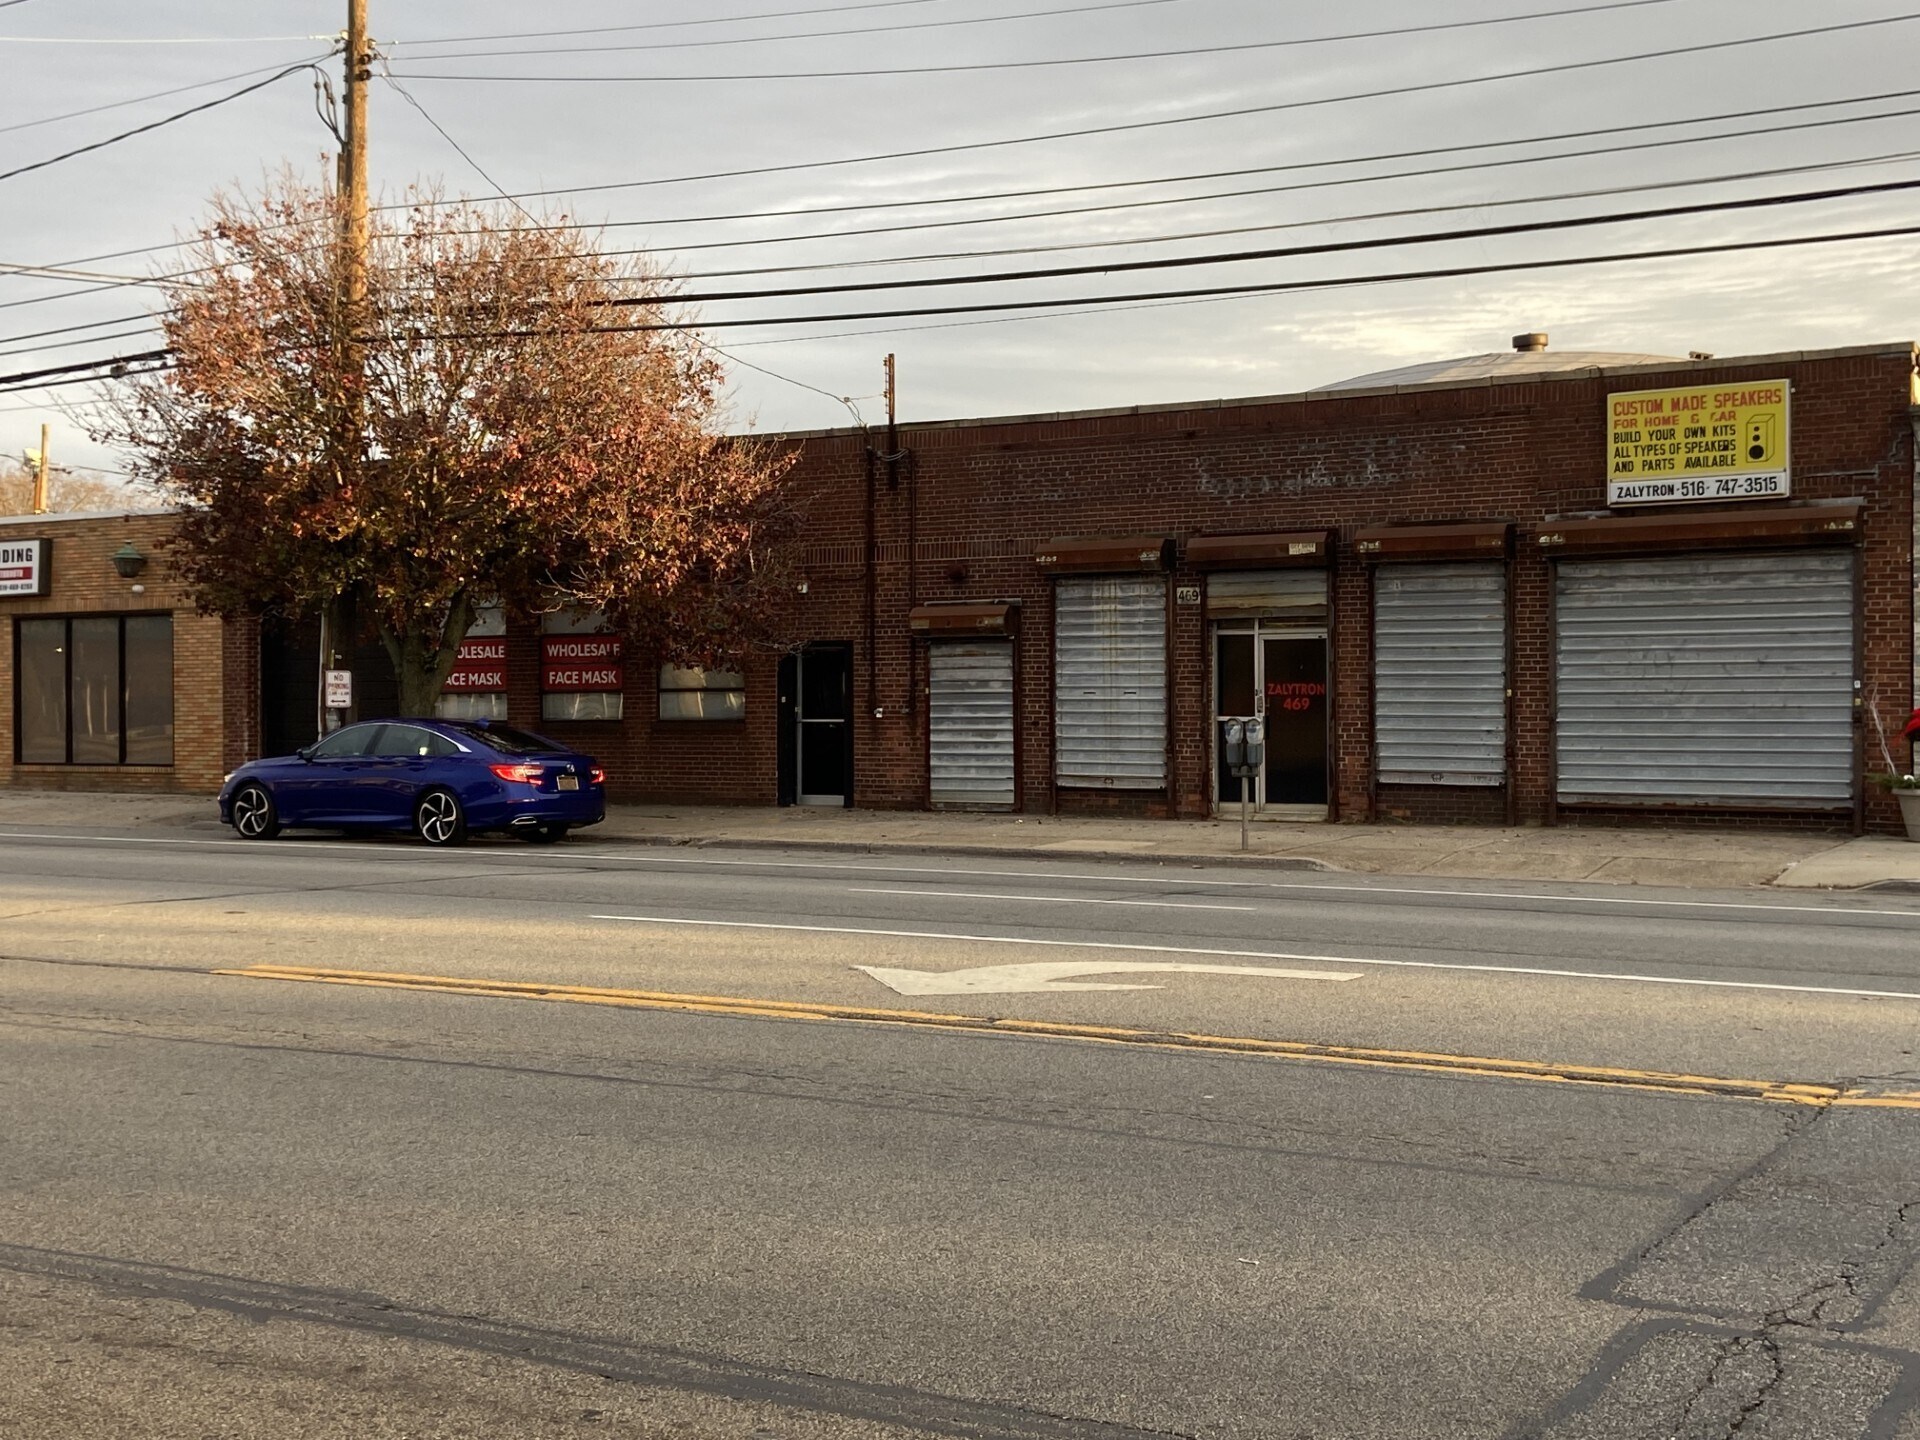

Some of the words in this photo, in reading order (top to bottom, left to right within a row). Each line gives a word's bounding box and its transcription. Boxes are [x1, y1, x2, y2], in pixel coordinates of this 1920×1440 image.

[1614, 398, 1664, 417] CUSTOM
[1671, 394, 1708, 413] MADE
[1714, 388, 1782, 409] SPEAKERS
[1614, 418, 1638, 430] FOR
[1644, 414, 1680, 428] HOME
[1710, 410, 1737, 423] CAR
[1614, 430, 1642, 444] BUILD
[1647, 428, 1676, 441] YOUR
[1685, 426, 1706, 439] OWN
[1712, 424, 1736, 437] KITS
[1614, 446, 1631, 459] ALL
[1633, 444, 1666, 457] TYPES
[1670, 442, 1682, 455] OF
[1685, 438, 1736, 454] SPEAKERS
[1614, 460, 1634, 473] AND
[1641, 457, 1675, 471] PARTS
[1685, 453, 1736, 469] AVAILABLE
[0, 548, 33, 563] DING
[1178, 589, 1199, 602] 469
[457, 645, 505, 659] OLESALE
[446, 672, 466, 686] ACE
[468, 672, 502, 686] MASK
[549, 671, 579, 684] FACE
[582, 670, 617, 684] MASK
[1267, 683, 1325, 696] ZALYTRON
[1283, 698, 1310, 711] 469
